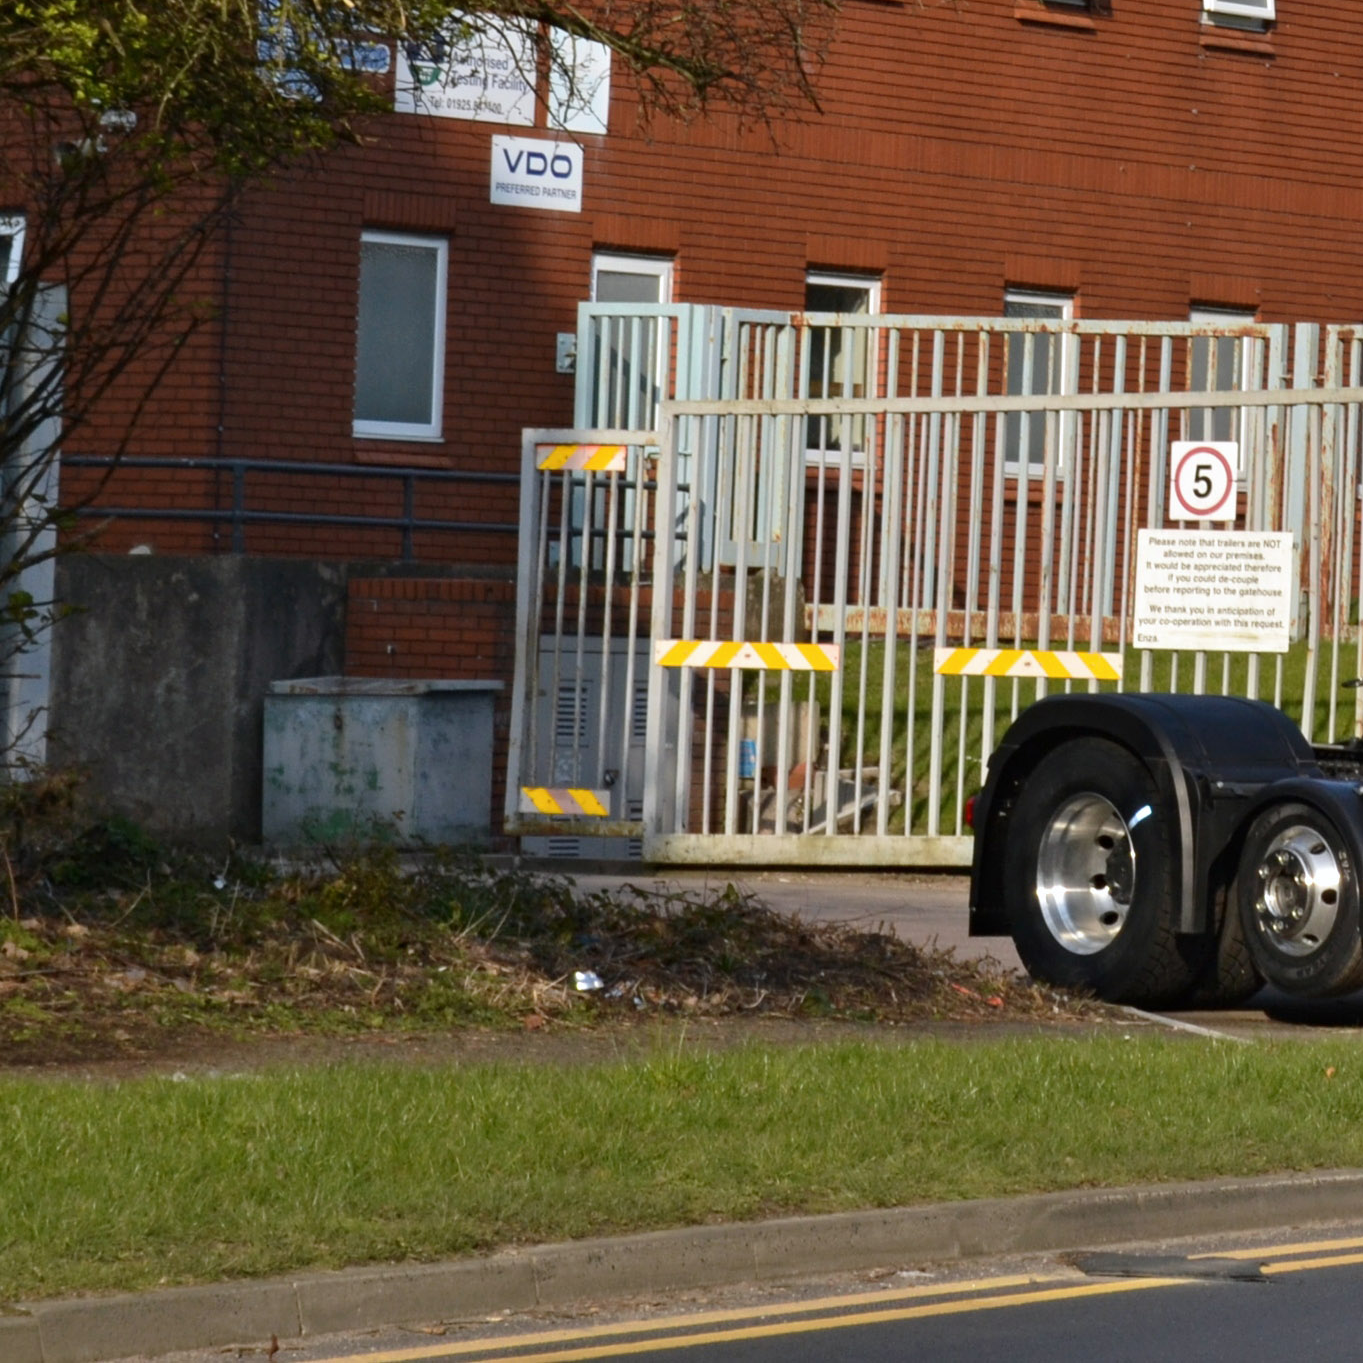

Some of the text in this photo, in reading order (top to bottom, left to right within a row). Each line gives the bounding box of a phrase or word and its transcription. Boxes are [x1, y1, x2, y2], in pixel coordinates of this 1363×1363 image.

[453, 51, 508, 70] Athoised
[492, 75, 527, 93] Facility
[503, 148, 572, 179] VDO
[495, 182, 576, 200] PREFERRED PARTNER
[1193, 465, 1212, 498] 5
[1148, 537, 1281, 548] Please note that trailers are NOT
[1163, 550, 1194, 559] allowed
[1154, 562, 1178, 570] would
[1181, 562, 1190, 570] be
[1193, 563, 1241, 573] appreciated
[1244, 564, 1281, 572] therefore
[1193, 574, 1216, 582] could
[1218, 575, 1259, 585] de-couple
[1144, 585, 1170, 594] before
[1172, 586, 1210, 596] reporting
[1223, 587, 1236, 595] the
[1239, 588, 1282, 597] gatehouse
[1149, 605, 1275, 617] We thank you in anticipation of
[1138, 618, 1156, 626] your
[1159, 617, 1212, 628] co-operation
[1214, 618, 1231, 626] with
[1233, 619, 1248, 627] this
